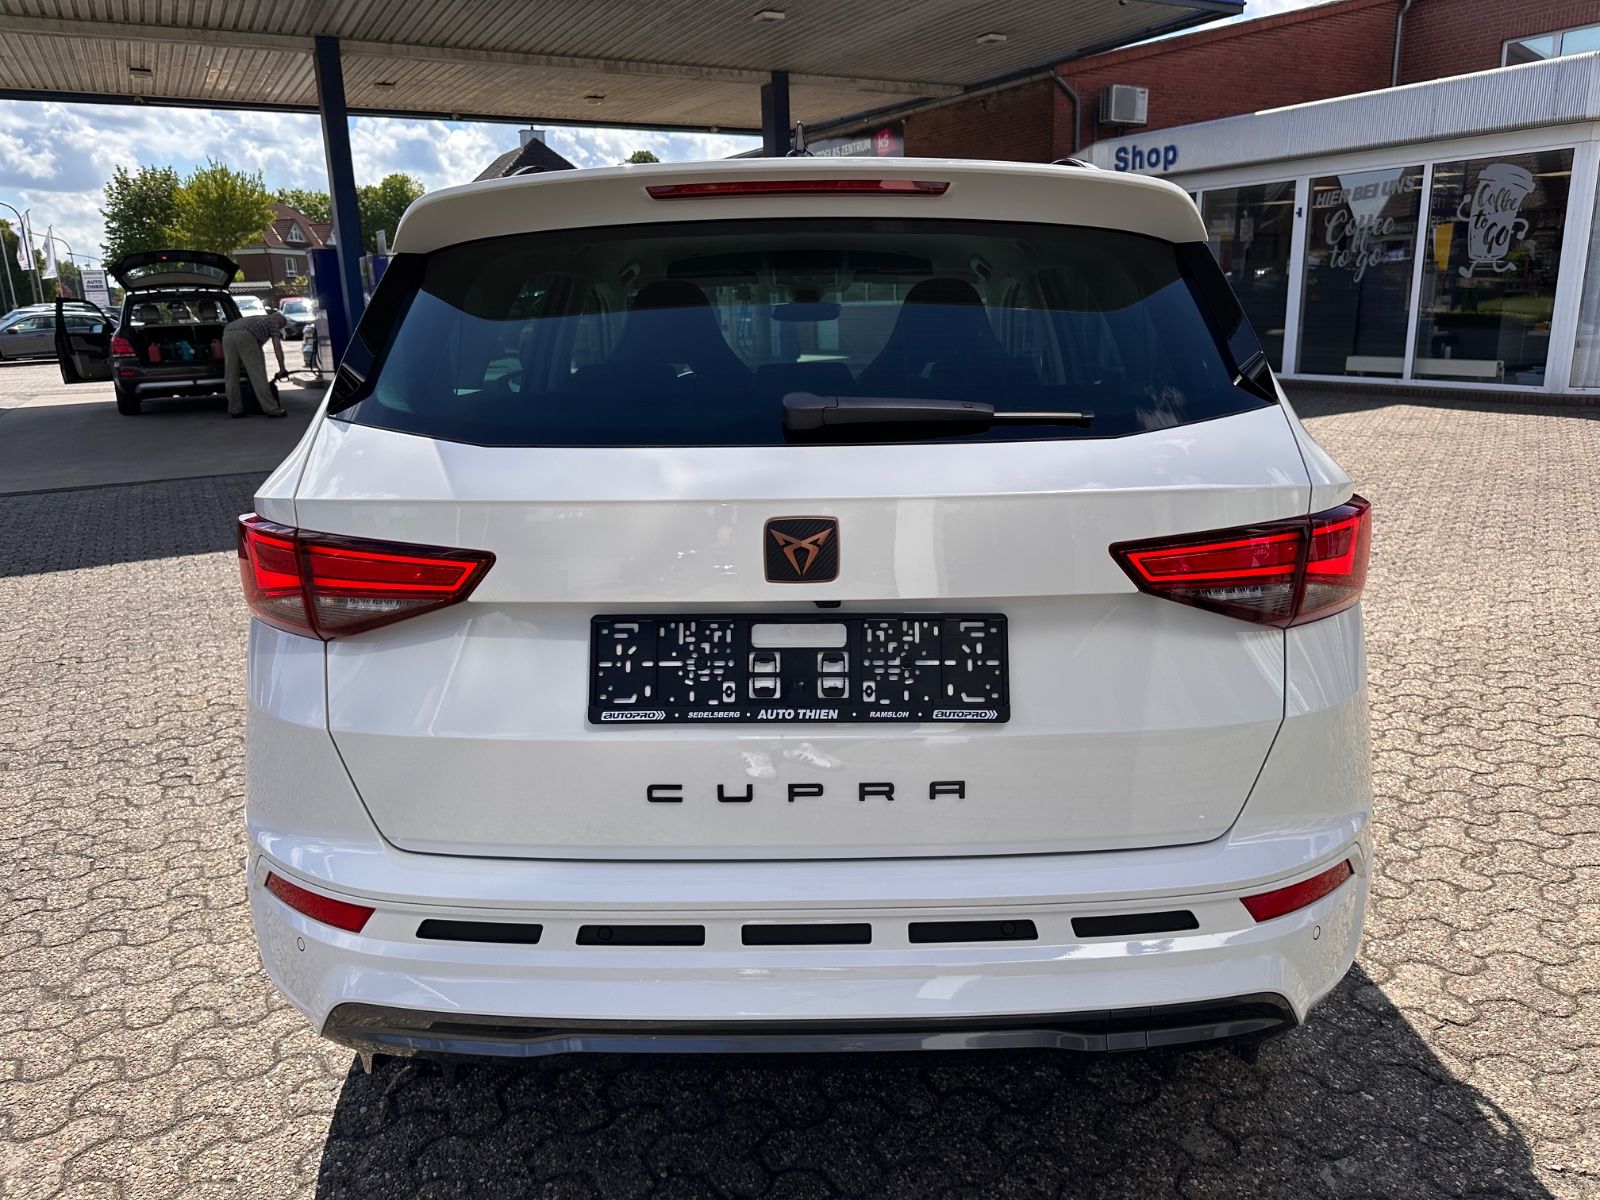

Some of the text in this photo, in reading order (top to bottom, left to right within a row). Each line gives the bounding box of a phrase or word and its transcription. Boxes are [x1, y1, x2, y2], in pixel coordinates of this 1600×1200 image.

[841, 138, 872, 155] ZENTRUM
[1114, 144, 1178, 172] Shop
[1315, 174, 1416, 206] HIER BEI UNS
[1476, 182, 1518, 213] Coffee
[1324, 209, 1395, 253] Coffee
[1473, 209, 1490, 230] to
[1328, 244, 1381, 283] to go
[687, 711, 741, 719] SEDELSBERG
[757, 709, 795, 720] AUTO
[797, 708, 839, 720] THIEN
[646, 780, 966, 803] CUPRA
